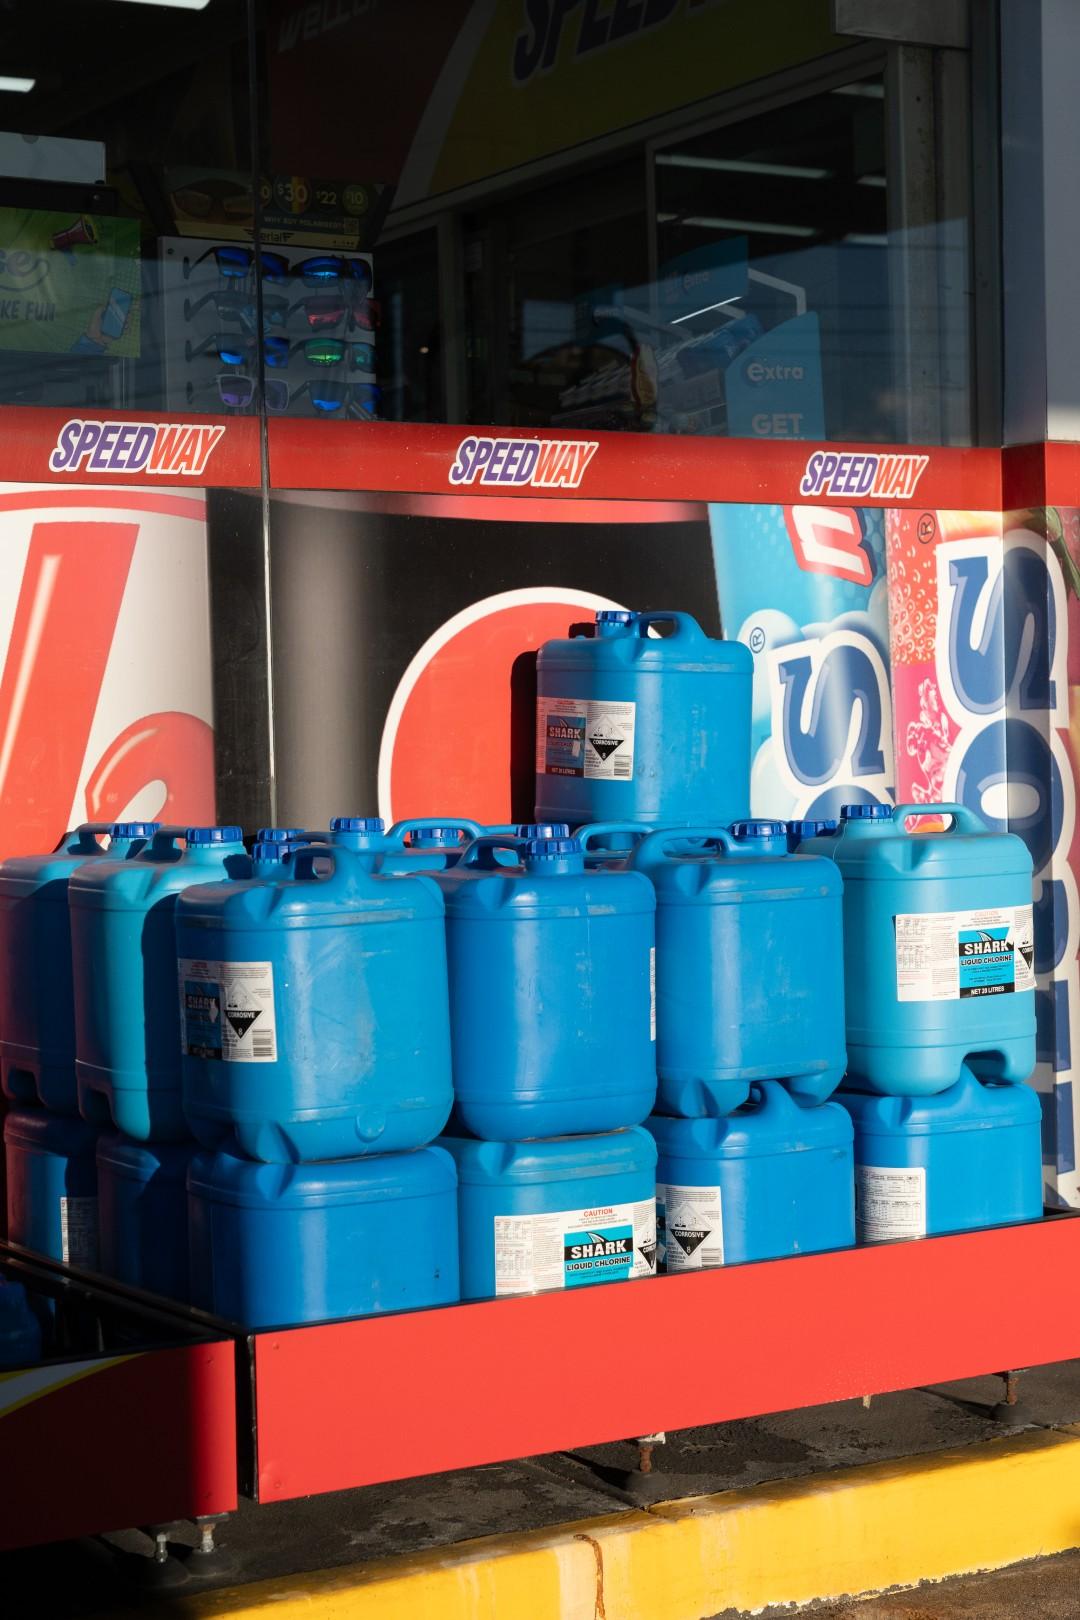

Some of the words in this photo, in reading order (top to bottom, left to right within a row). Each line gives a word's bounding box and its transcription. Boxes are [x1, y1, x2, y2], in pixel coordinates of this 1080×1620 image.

[746, 362, 804, 383] extra
[752, 412, 804, 434] GET
[50, 420, 225, 474] SPEEDWAY
[449, 437, 599, 487] SPEEDWAY
[800, 452, 928, 498] SPEEDWAY
[550, 727, 582, 740] SHARK
[593, 738, 619, 746] CORROSIVE
[964, 939, 1009, 955] SHARK
[961, 957, 983, 967] LIQUID
[984, 954, 1013, 965] CHLORINE
[971, 988, 981, 996] NET
[989, 986, 1005, 994] LITRES
[228, 1011, 256, 1020] CORROSIVE
[583, 1208, 614, 1218] CAUTION
[674, 1230, 705, 1238] CORROSIVE
[570, 1239, 627, 1259] SHARK
[566, 1261, 593, 1271] LIQUID
[594, 1256, 631, 1269] CHLORINE
